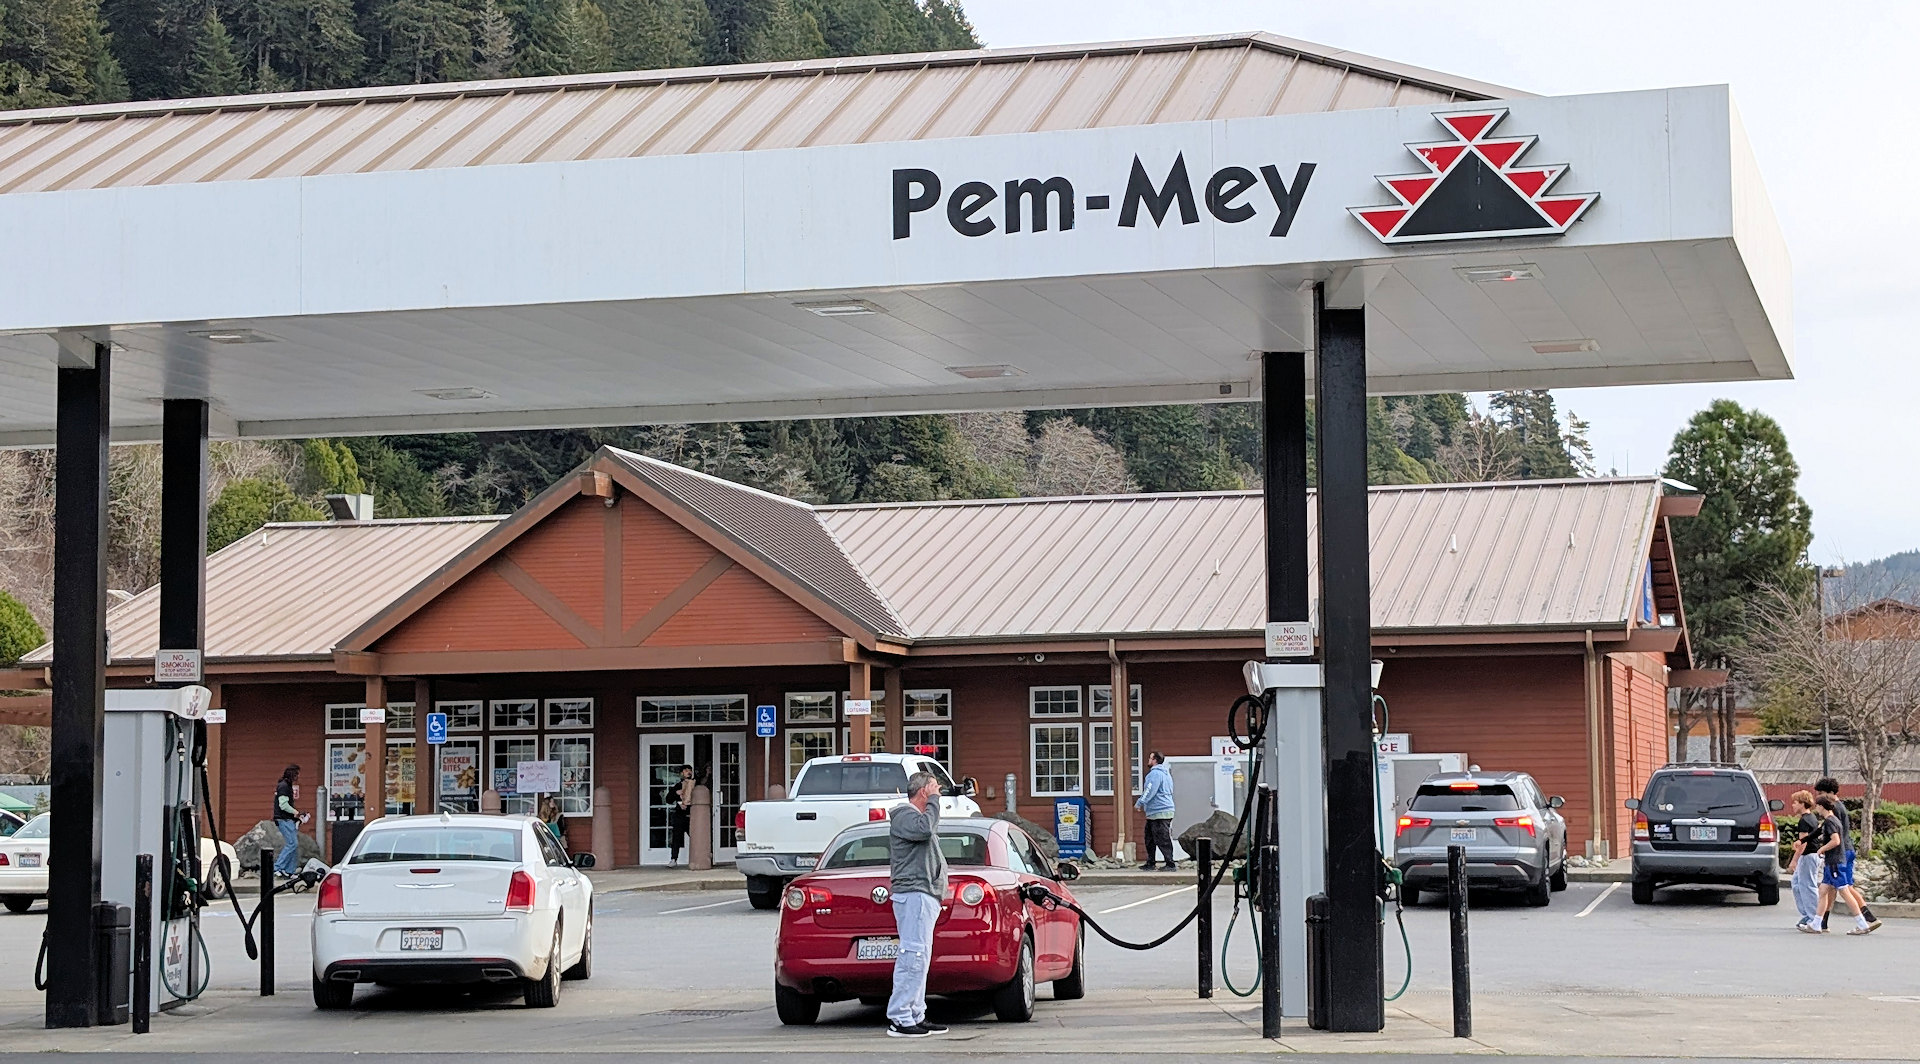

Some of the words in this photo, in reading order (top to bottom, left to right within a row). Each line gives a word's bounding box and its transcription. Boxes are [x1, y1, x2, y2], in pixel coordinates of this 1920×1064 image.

[892, 150, 1317, 239] Pem-Mey
[1283, 626, 1296, 634] NO
[1271, 634, 1308, 642] SMOKING
[160, 661, 196, 669] SMOKING
[914, 744, 938, 755] Open
[1380, 743, 1398, 752] CE
[442, 756, 471, 764] CHICKEN
[442, 764, 461, 772] BITES
